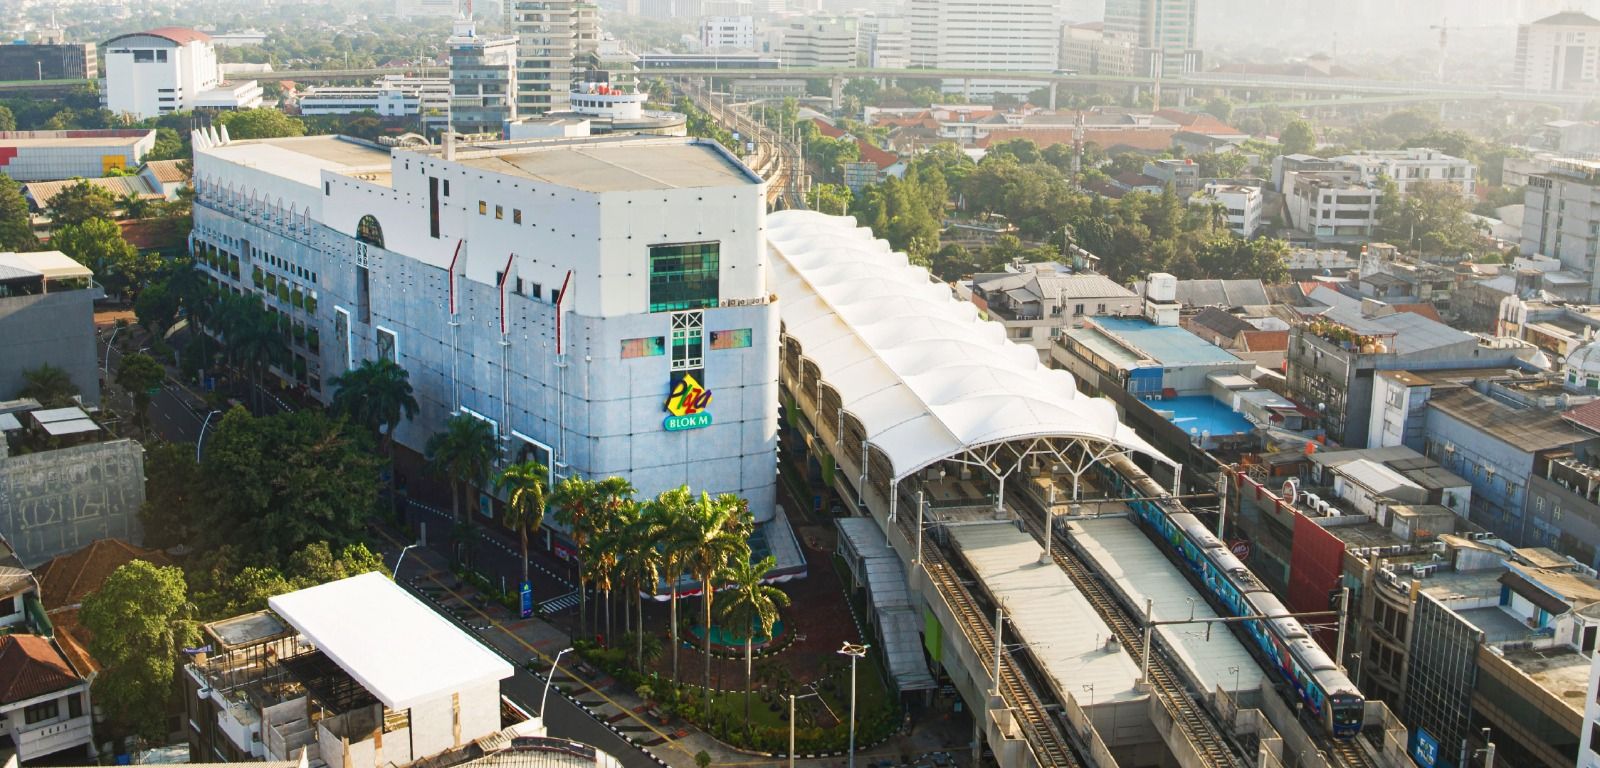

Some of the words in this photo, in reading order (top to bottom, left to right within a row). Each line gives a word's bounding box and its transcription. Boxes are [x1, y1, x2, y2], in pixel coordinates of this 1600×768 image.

[663, 379, 712, 414] Plaza
[670, 417, 696, 428] BLOK
[698, 416, 708, 425] M
